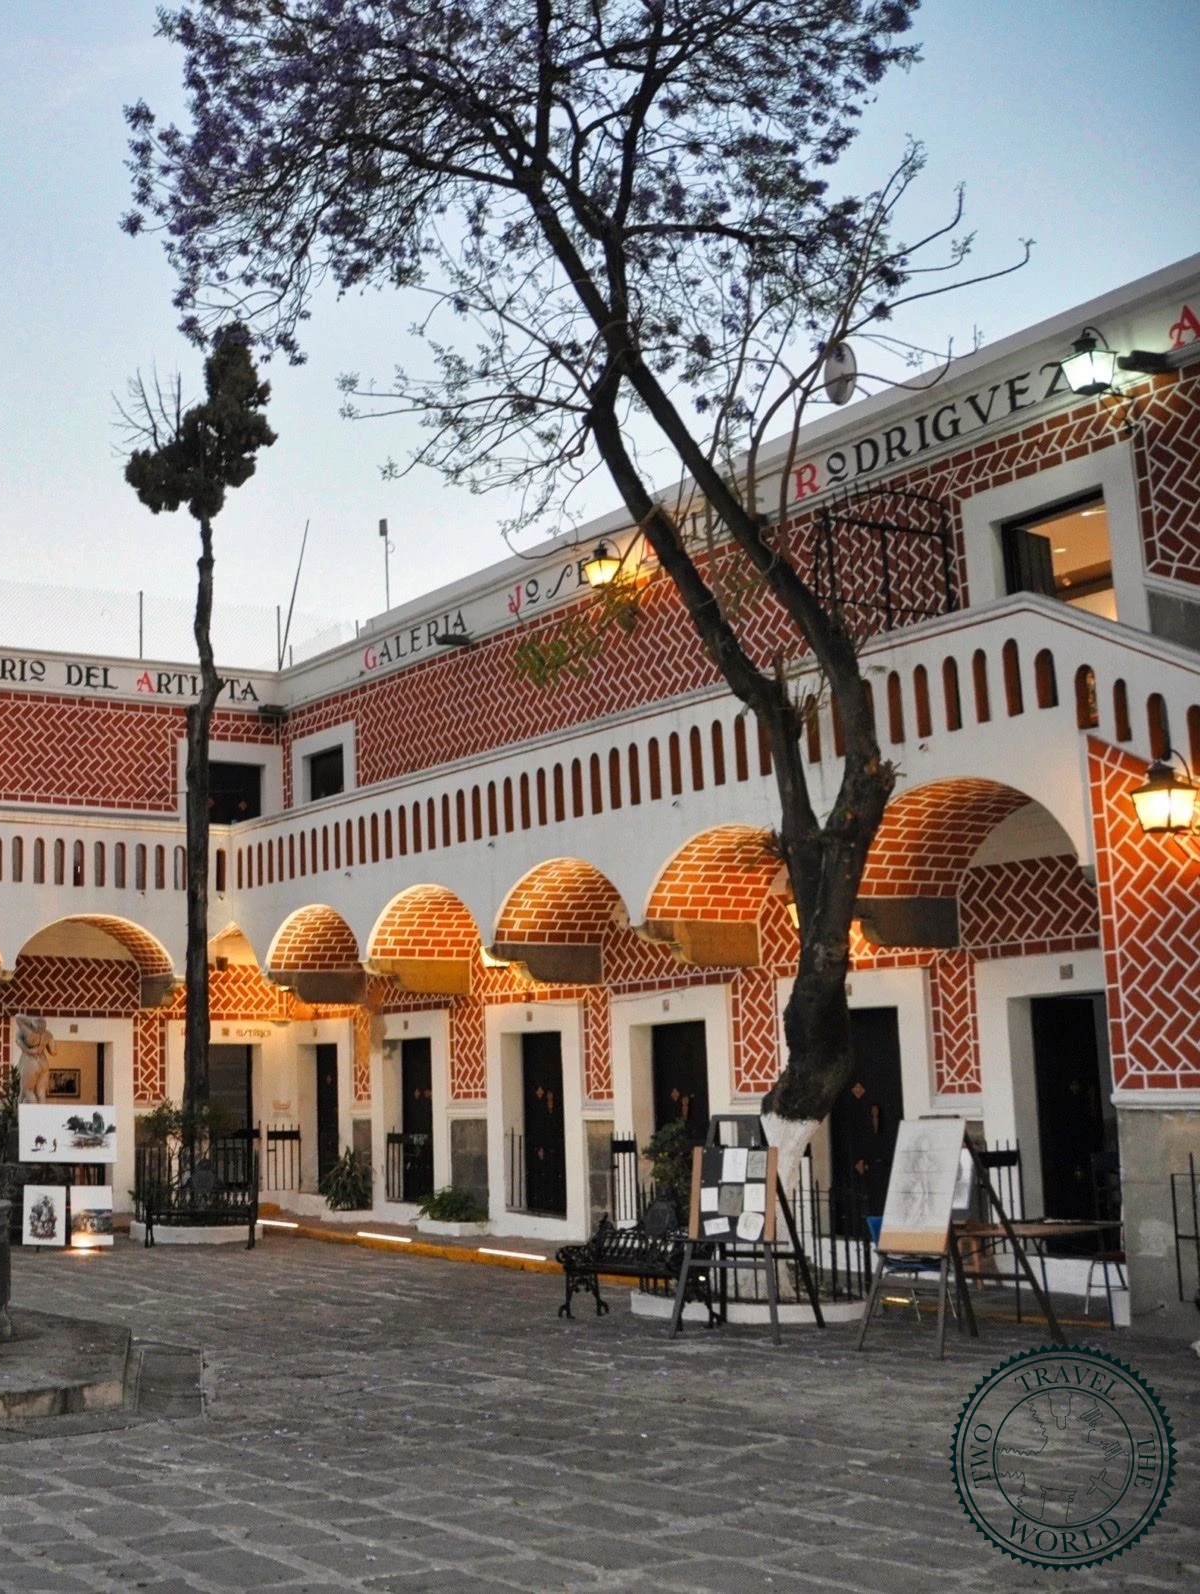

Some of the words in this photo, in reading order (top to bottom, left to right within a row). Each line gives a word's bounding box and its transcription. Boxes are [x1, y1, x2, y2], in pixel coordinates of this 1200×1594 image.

[363, 609, 468, 671] GALERIA
[65, 663, 119, 690] DEL
[136, 671, 260, 702] ARTITA
